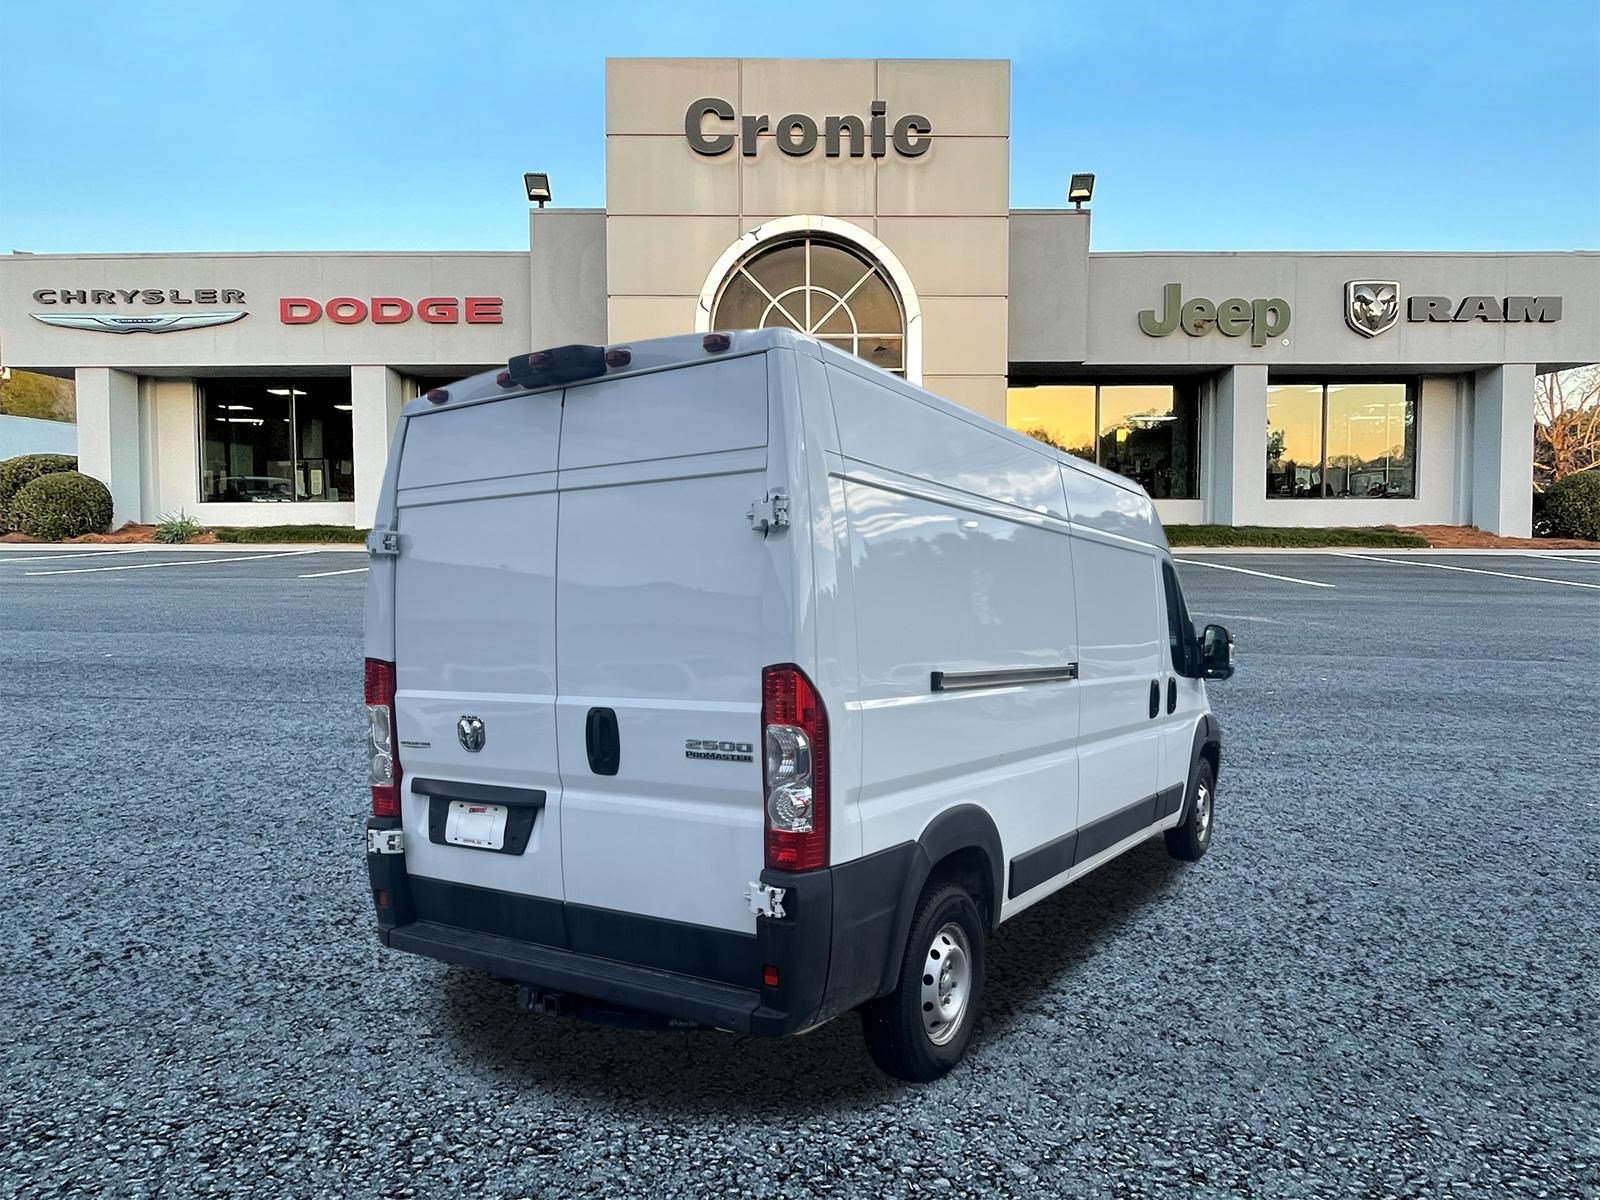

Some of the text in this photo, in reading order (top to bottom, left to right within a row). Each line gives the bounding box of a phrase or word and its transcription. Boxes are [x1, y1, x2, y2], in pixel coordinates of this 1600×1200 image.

[685, 97, 933, 158] Cronic
[33, 289, 247, 305] CHRYSLER
[279, 297, 504, 324] DODGE
[1407, 296, 1563, 323] RAM
[1138, 283, 1291, 348] Jeep
[685, 739, 754, 753] 2500
